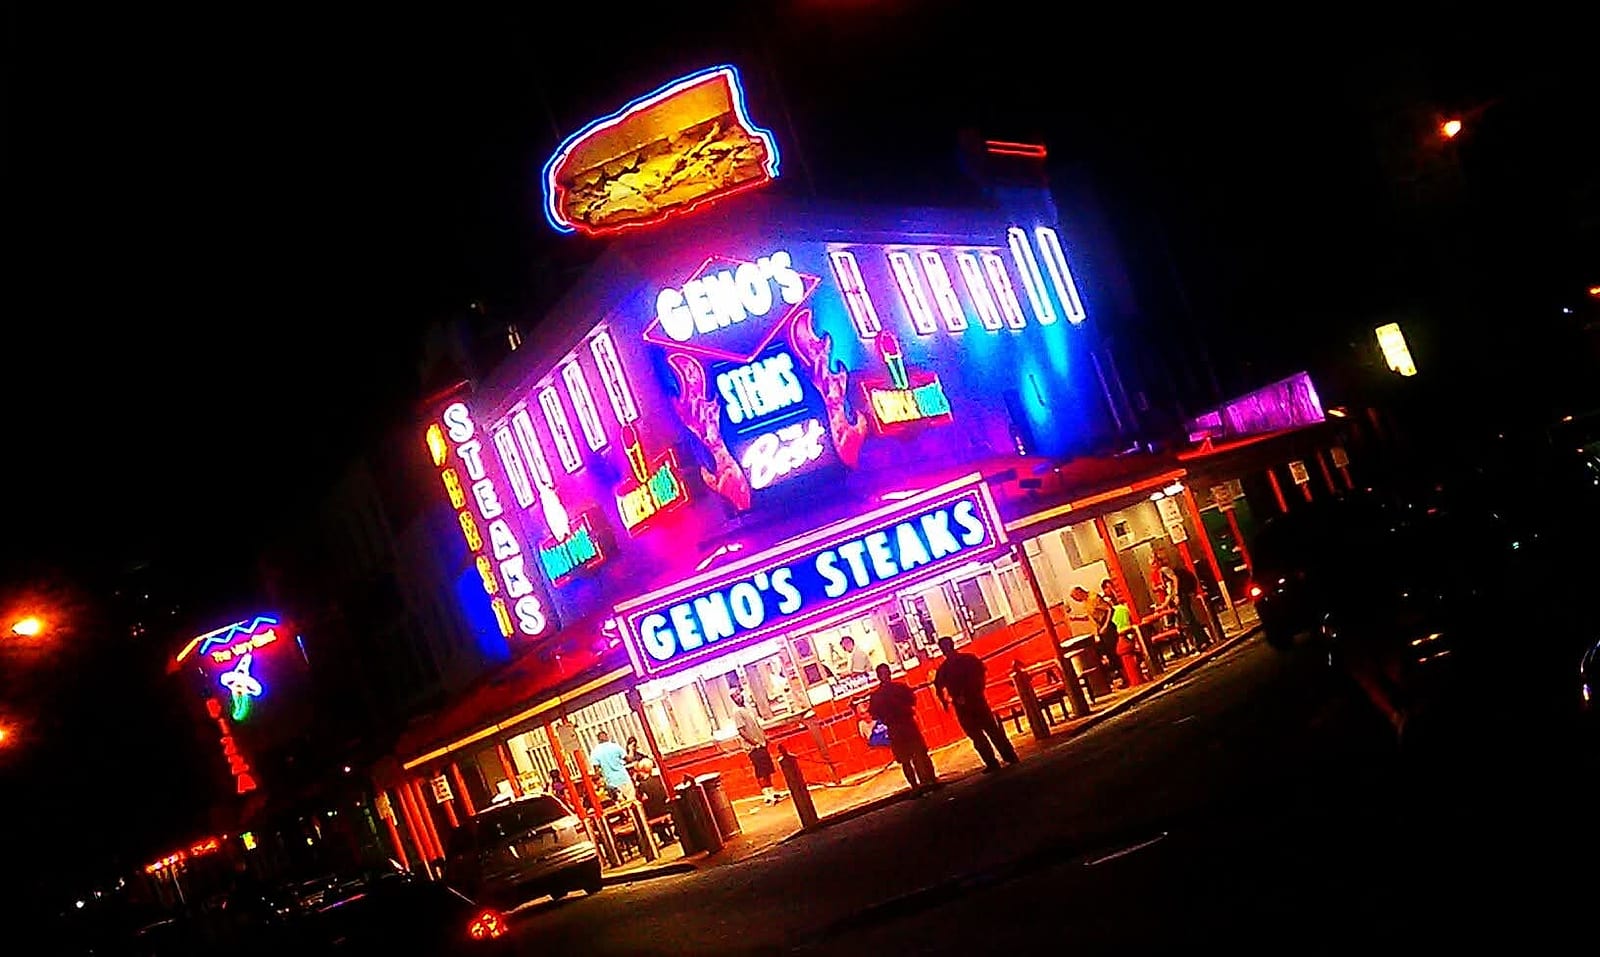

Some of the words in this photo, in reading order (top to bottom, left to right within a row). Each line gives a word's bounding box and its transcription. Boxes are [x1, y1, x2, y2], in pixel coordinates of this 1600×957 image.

[656, 250, 805, 341] GENO'S
[716, 352, 803, 423] STEAKS
[741, 418, 825, 490] Best
[443, 402, 546, 635] STEAKS
[639, 567, 801, 660] GENO'S
[815, 499, 985, 598] STEAKS
